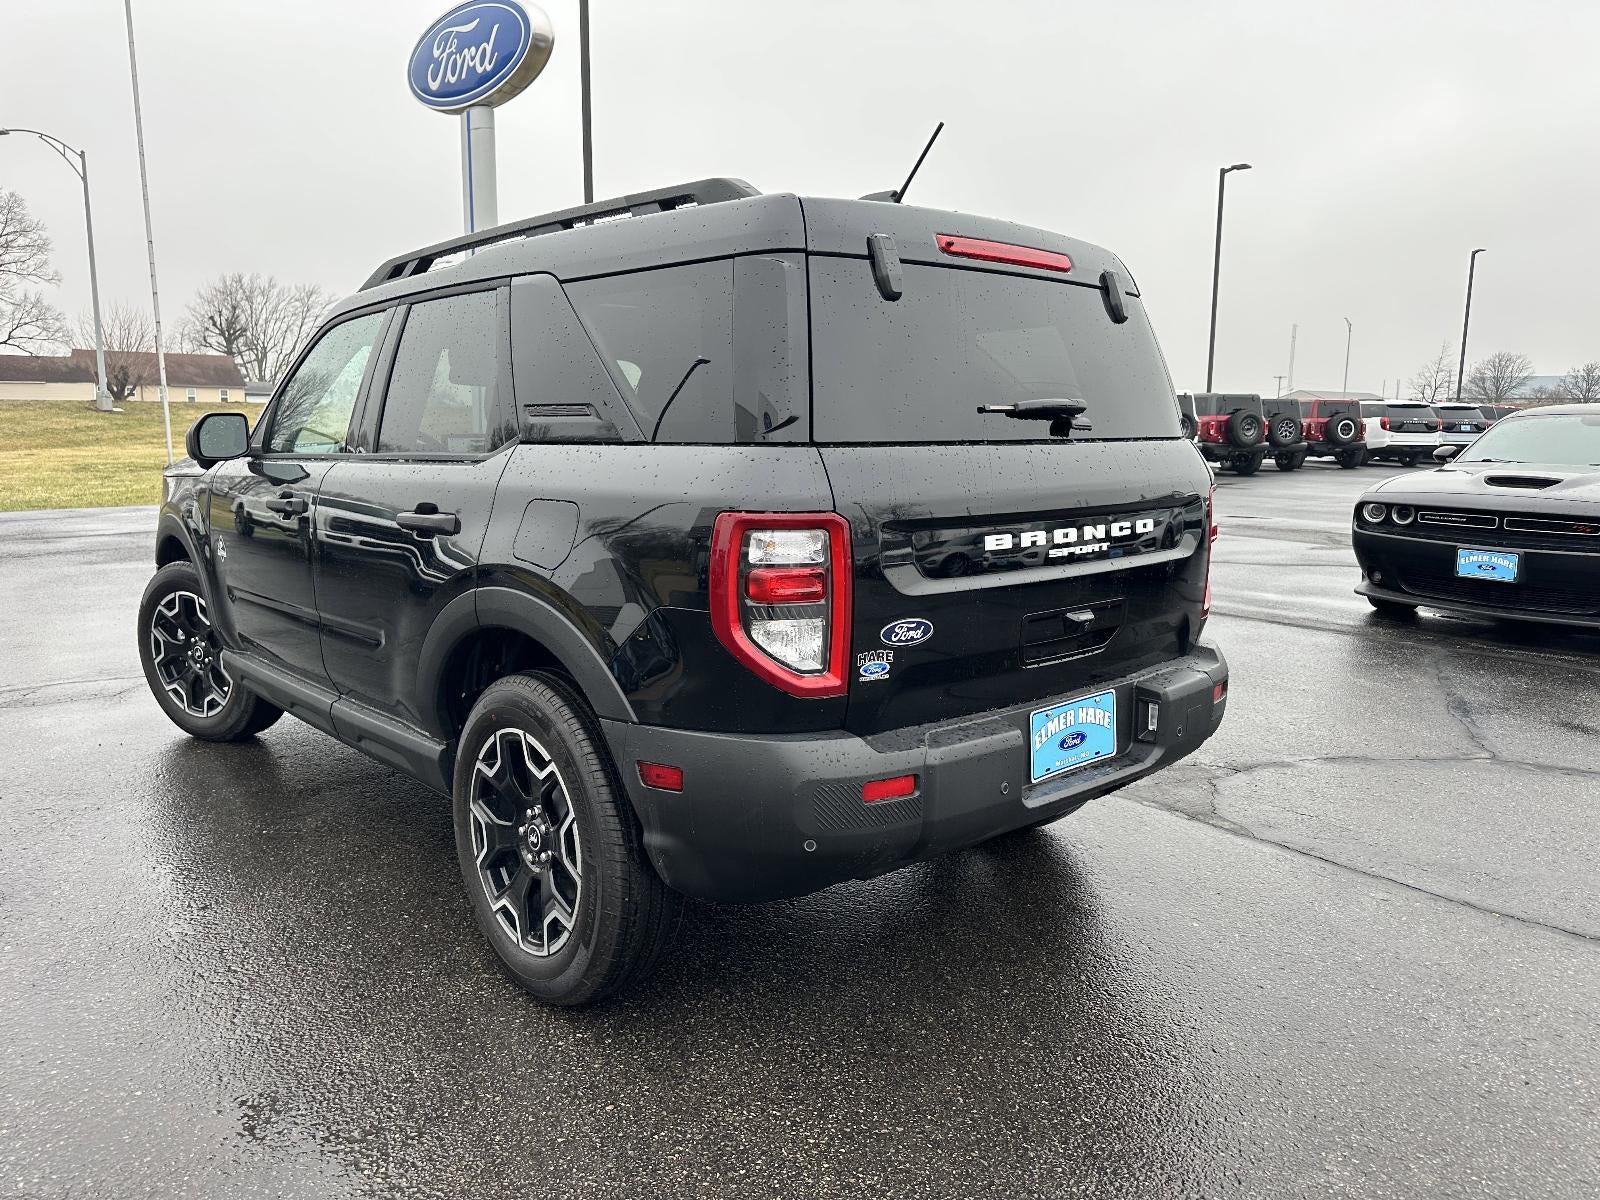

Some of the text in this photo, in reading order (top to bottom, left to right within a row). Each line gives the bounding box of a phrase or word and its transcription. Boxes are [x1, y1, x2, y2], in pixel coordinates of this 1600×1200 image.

[427, 18, 499, 91] Ford
[984, 518, 1154, 551] BRONCO
[1048, 542, 1110, 558] SPORT
[1460, 555, 1489, 565] ELMER
[892, 623, 924, 641] Ford
[858, 650, 893, 666] HARE
[1034, 707, 1111, 752] ELMER HARE
[1063, 734, 1081, 749] Ford
